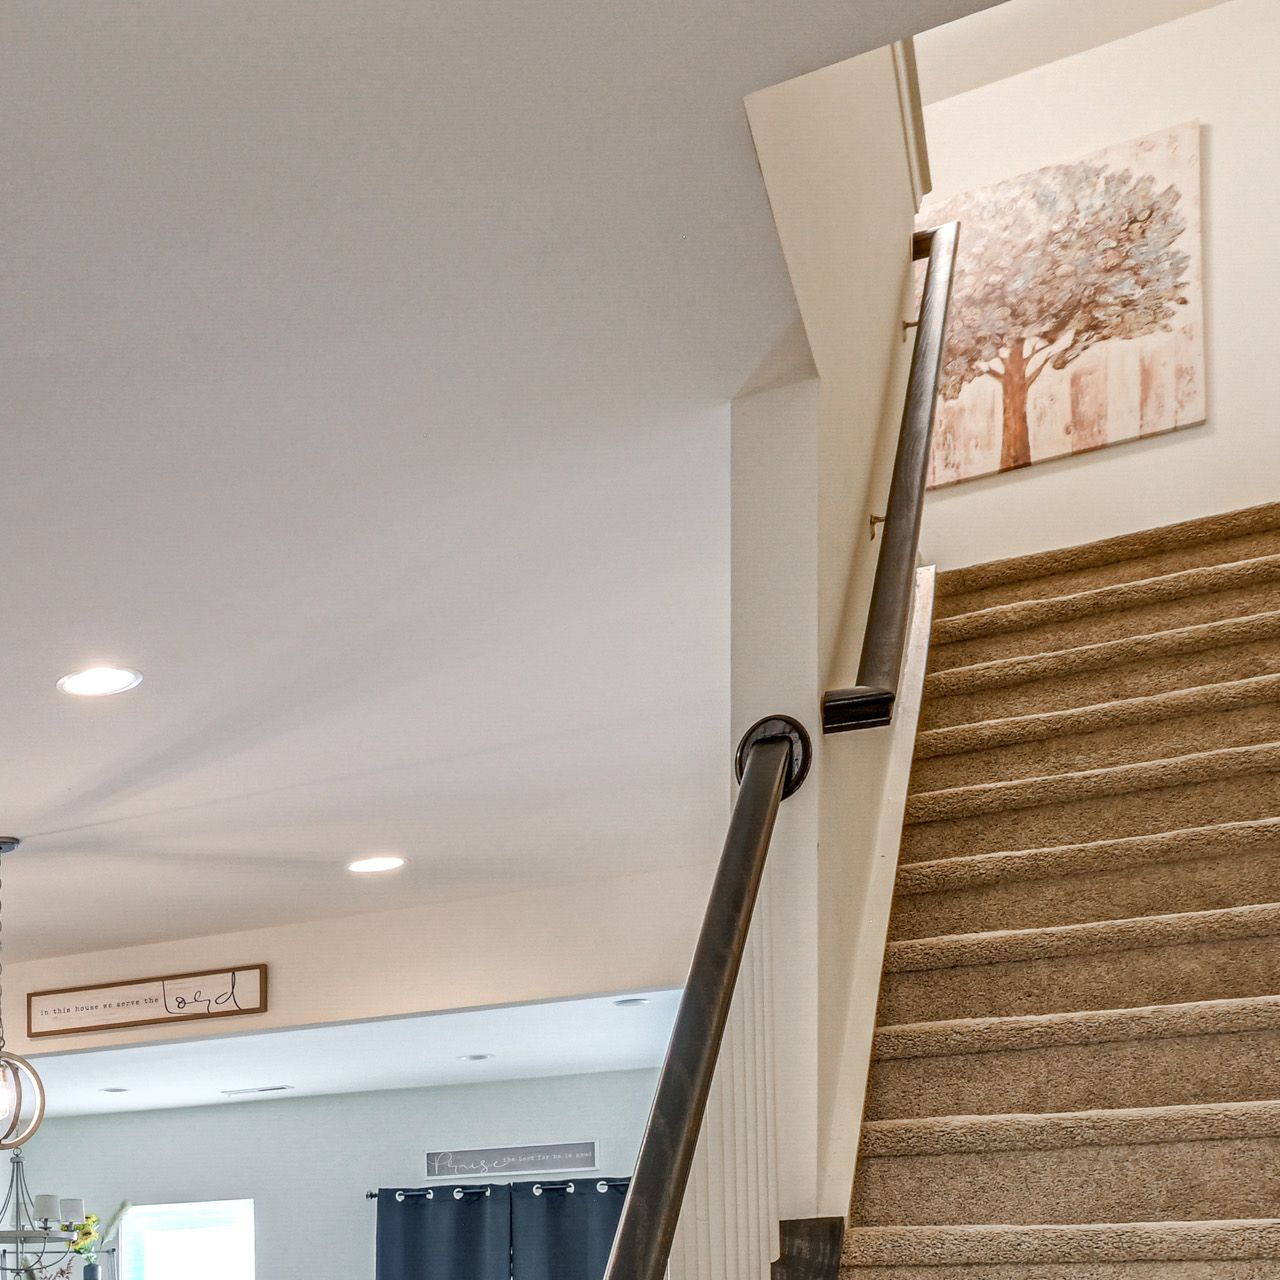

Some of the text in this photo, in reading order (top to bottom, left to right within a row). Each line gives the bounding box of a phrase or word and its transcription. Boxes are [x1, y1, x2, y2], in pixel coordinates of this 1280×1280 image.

[53, 1007, 71, 1015] this
[75, 1004, 99, 1012] house
[116, 999, 140, 1008] serve
